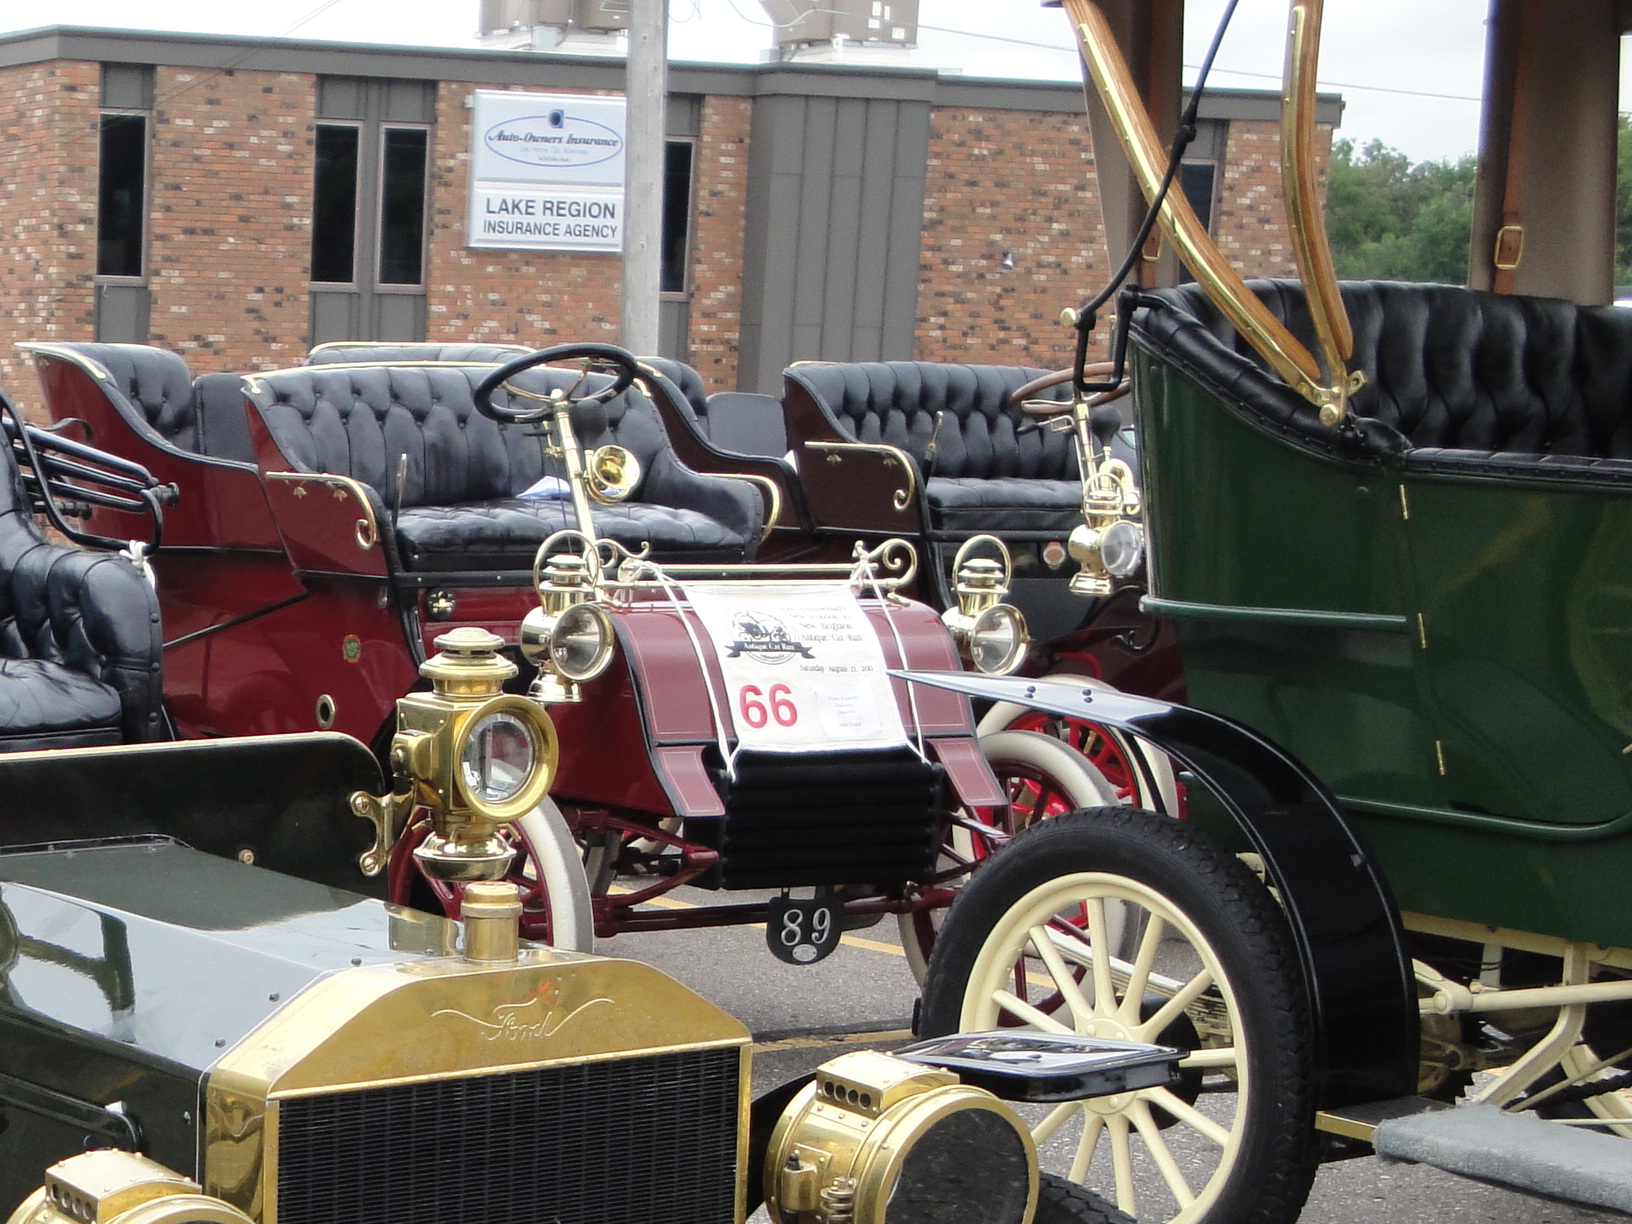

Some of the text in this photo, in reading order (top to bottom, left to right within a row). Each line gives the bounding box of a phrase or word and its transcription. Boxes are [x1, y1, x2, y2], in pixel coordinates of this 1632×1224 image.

[488, 129, 619, 147] Auto-Owners Insurance
[485, 197, 616, 219] LAKE REGION
[483, 219, 618, 239] INSURANCE AGENCY
[739, 683, 798, 729] 66
[781, 907, 831, 946] 89
